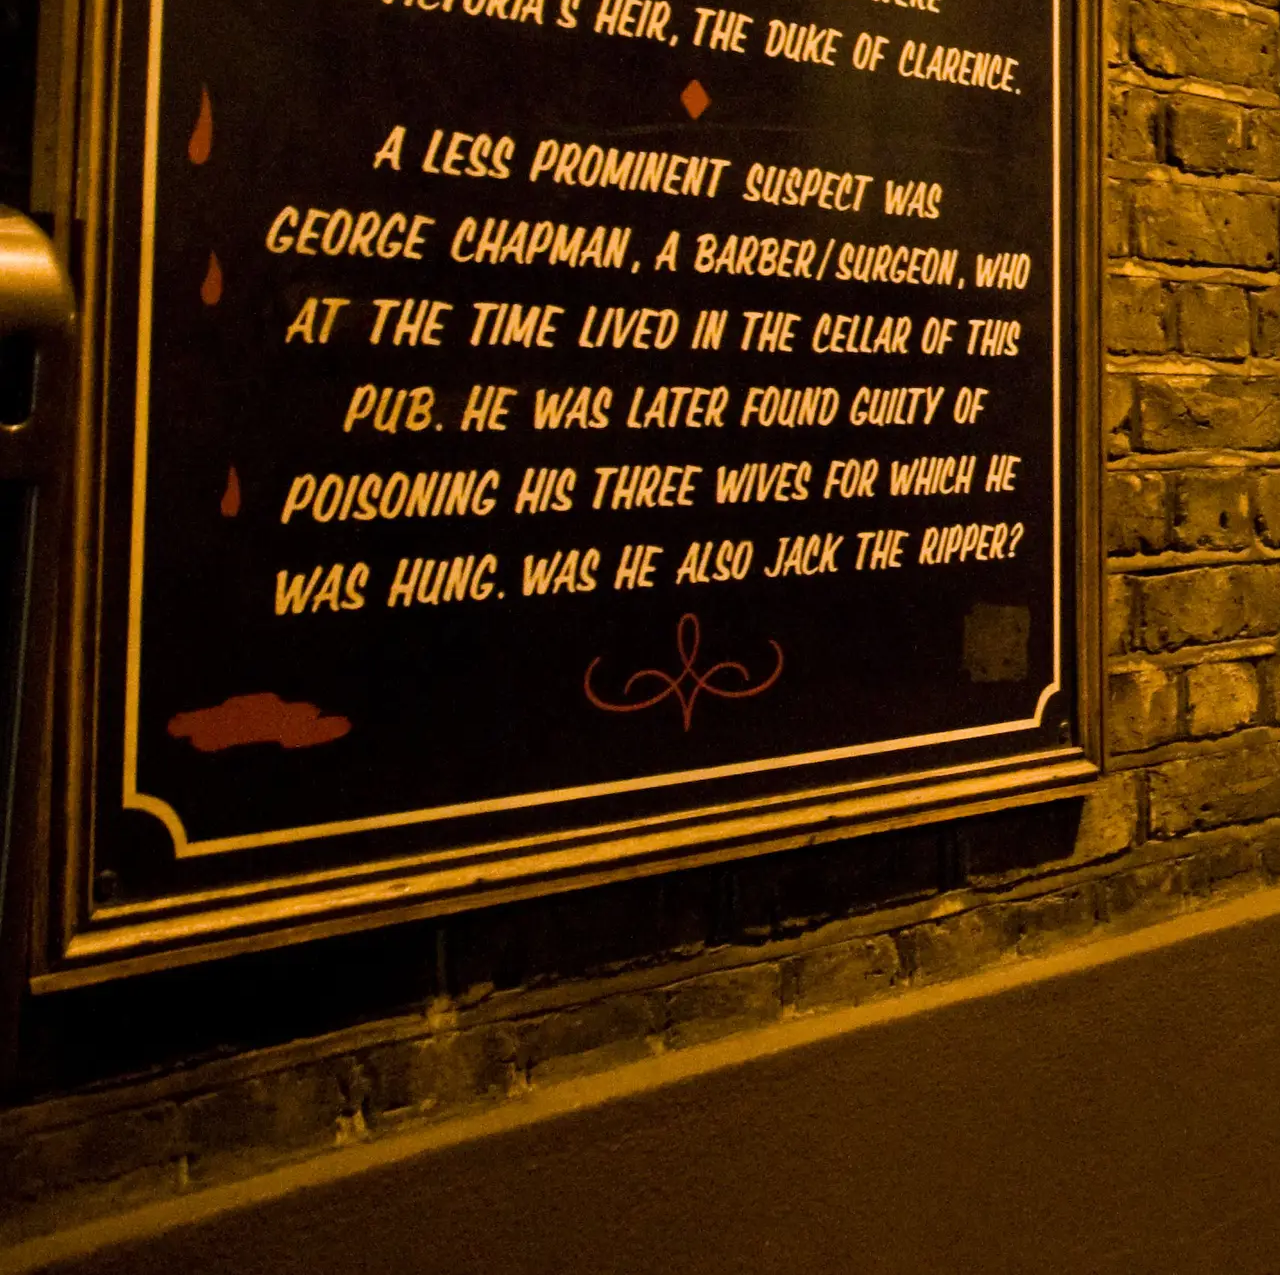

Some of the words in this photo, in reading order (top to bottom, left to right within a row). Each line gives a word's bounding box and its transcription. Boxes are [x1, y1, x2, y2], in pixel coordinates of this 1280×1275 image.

[693, 7, 754, 53] THE
[765, 19, 843, 66] DUKE
[853, 32, 890, 71] OF
[898, 40, 1021, 95] CLARENCE.
[373, 125, 406, 170] A
[422, 129, 515, 179] LESS
[529, 139, 731, 198] PROMINENT
[742, 162, 874, 211] SUSPECT
[885, 180, 943, 219] WAS
[266, 205, 435, 260] GEORGE
[451, 216, 640, 274] CHAPMAN,
[654, 230, 680, 271] A
[976, 252, 1031, 290] WHO
[285, 297, 345, 344] AT
[370, 298, 453, 346] THE
[470, 302, 565, 348] TIME
[578, 305, 679, 350] LIVED
[691, 310, 728, 350] IN
[741, 311, 801, 352] THE
[812, 313, 912, 354] CELLAR
[921, 317, 957, 354] OF
[967, 319, 1021, 357] THIS
[343, 384, 443, 434] PUB.
[461, 385, 518, 432] HE
[534, 386, 613, 430] WAS
[627, 386, 729, 429] LATER
[741, 386, 840, 428] FOUND
[850, 386, 945, 427] GUILTY
[953, 386, 989, 424] OF
[281, 469, 500, 524] POISONING
[515, 467, 577, 514] HIS
[592, 465, 703, 510] THREE
[716, 461, 812, 504] WIVES
[823, 458, 879, 499] FOR
[890, 455, 977, 496] WHICH
[985, 454, 1021, 492] HE
[275, 562, 370, 615] WAS
[387, 553, 505, 607] HUNG.
[522, 548, 601, 596] WAS
[614, 545, 664, 590] HE
[676, 540, 754, 584] ALSO
[764, 533, 844, 577] JACK
[855, 529, 910, 570] THE
[918, 522, 1024, 565] RIPPER?
